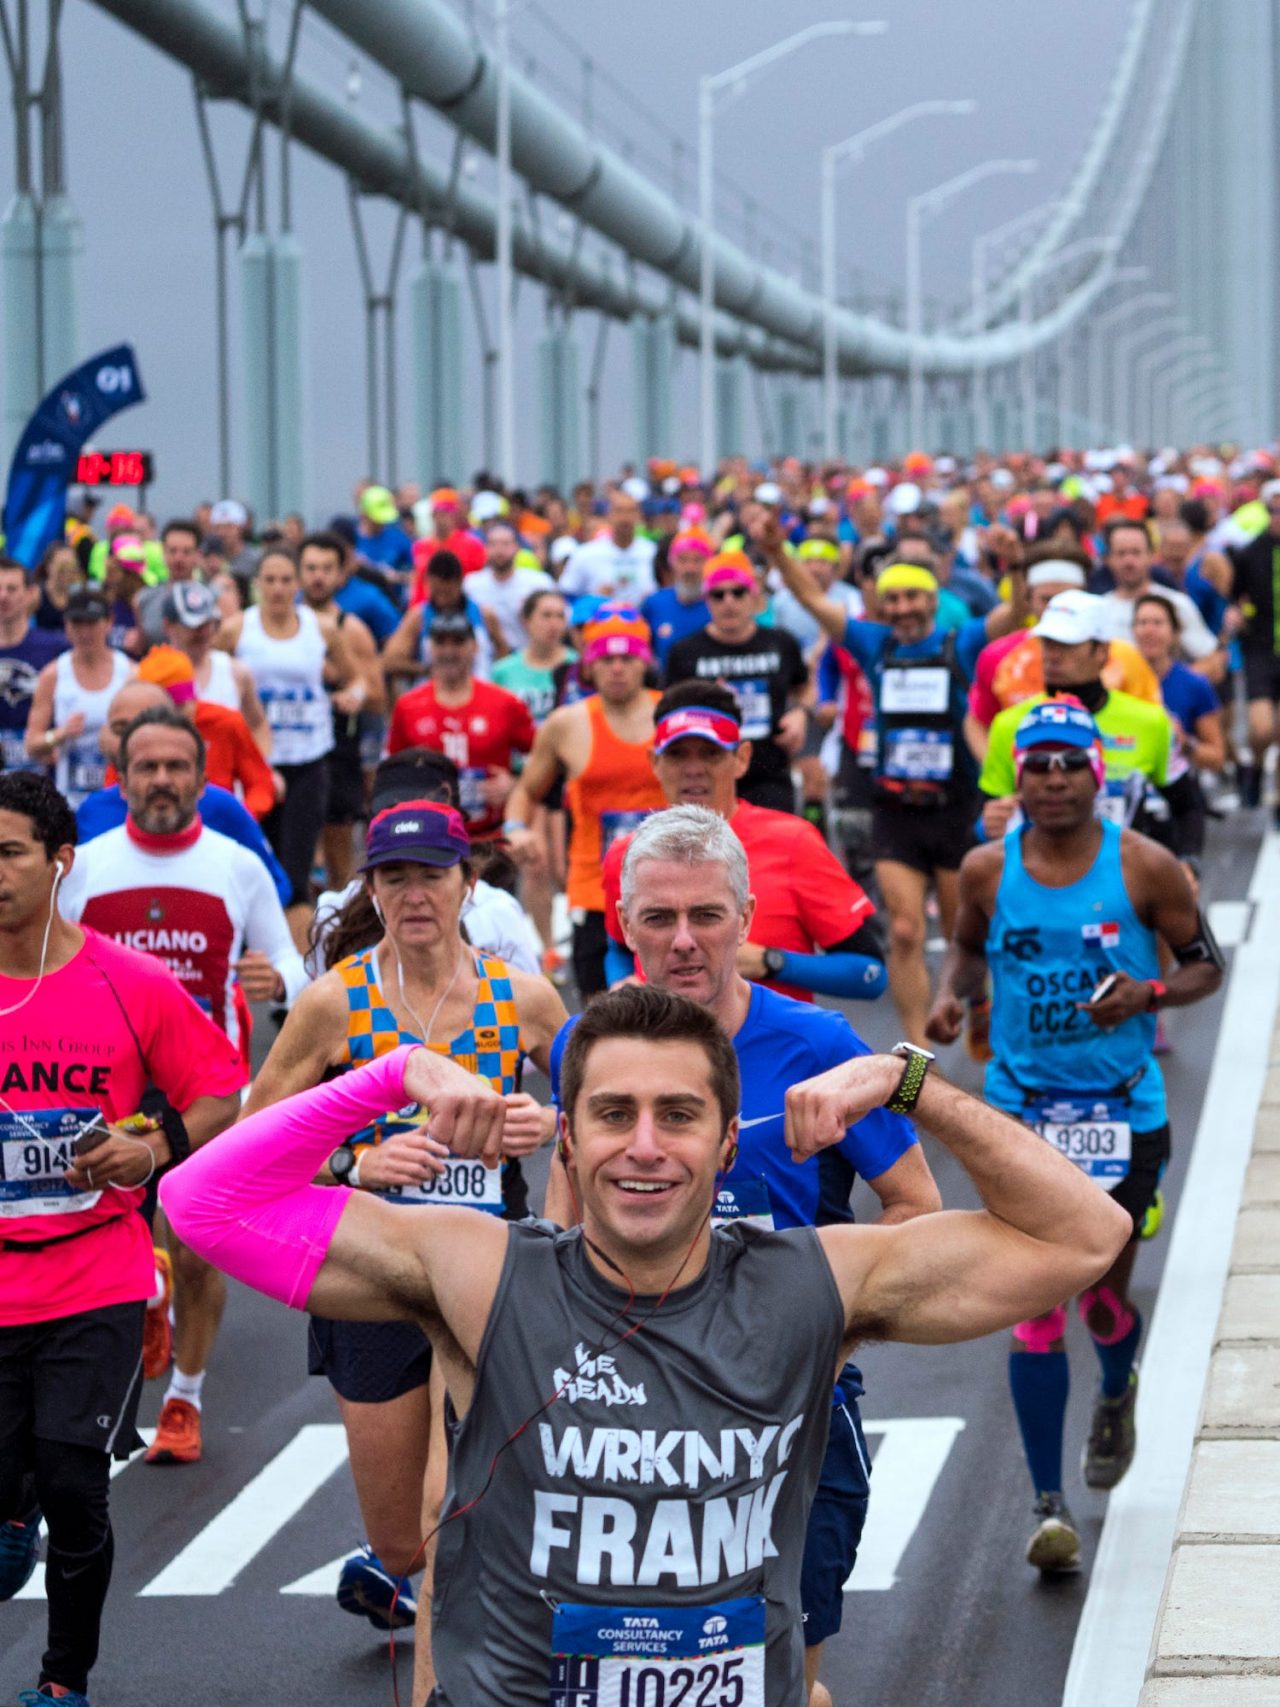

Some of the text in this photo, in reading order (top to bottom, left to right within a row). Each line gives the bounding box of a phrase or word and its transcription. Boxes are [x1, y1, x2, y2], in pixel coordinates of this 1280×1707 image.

[1056, 1127, 1116, 1156] 9303
[529, 1471, 789, 1588] FRANK
[622, 1617, 660, 1628] TATA
[597, 1628, 684, 1641] CONSULTANCY
[698, 1634, 729, 1649] TATA
[612, 1640, 668, 1653] SERVICES
[619, 1657, 745, 1707] 10225
